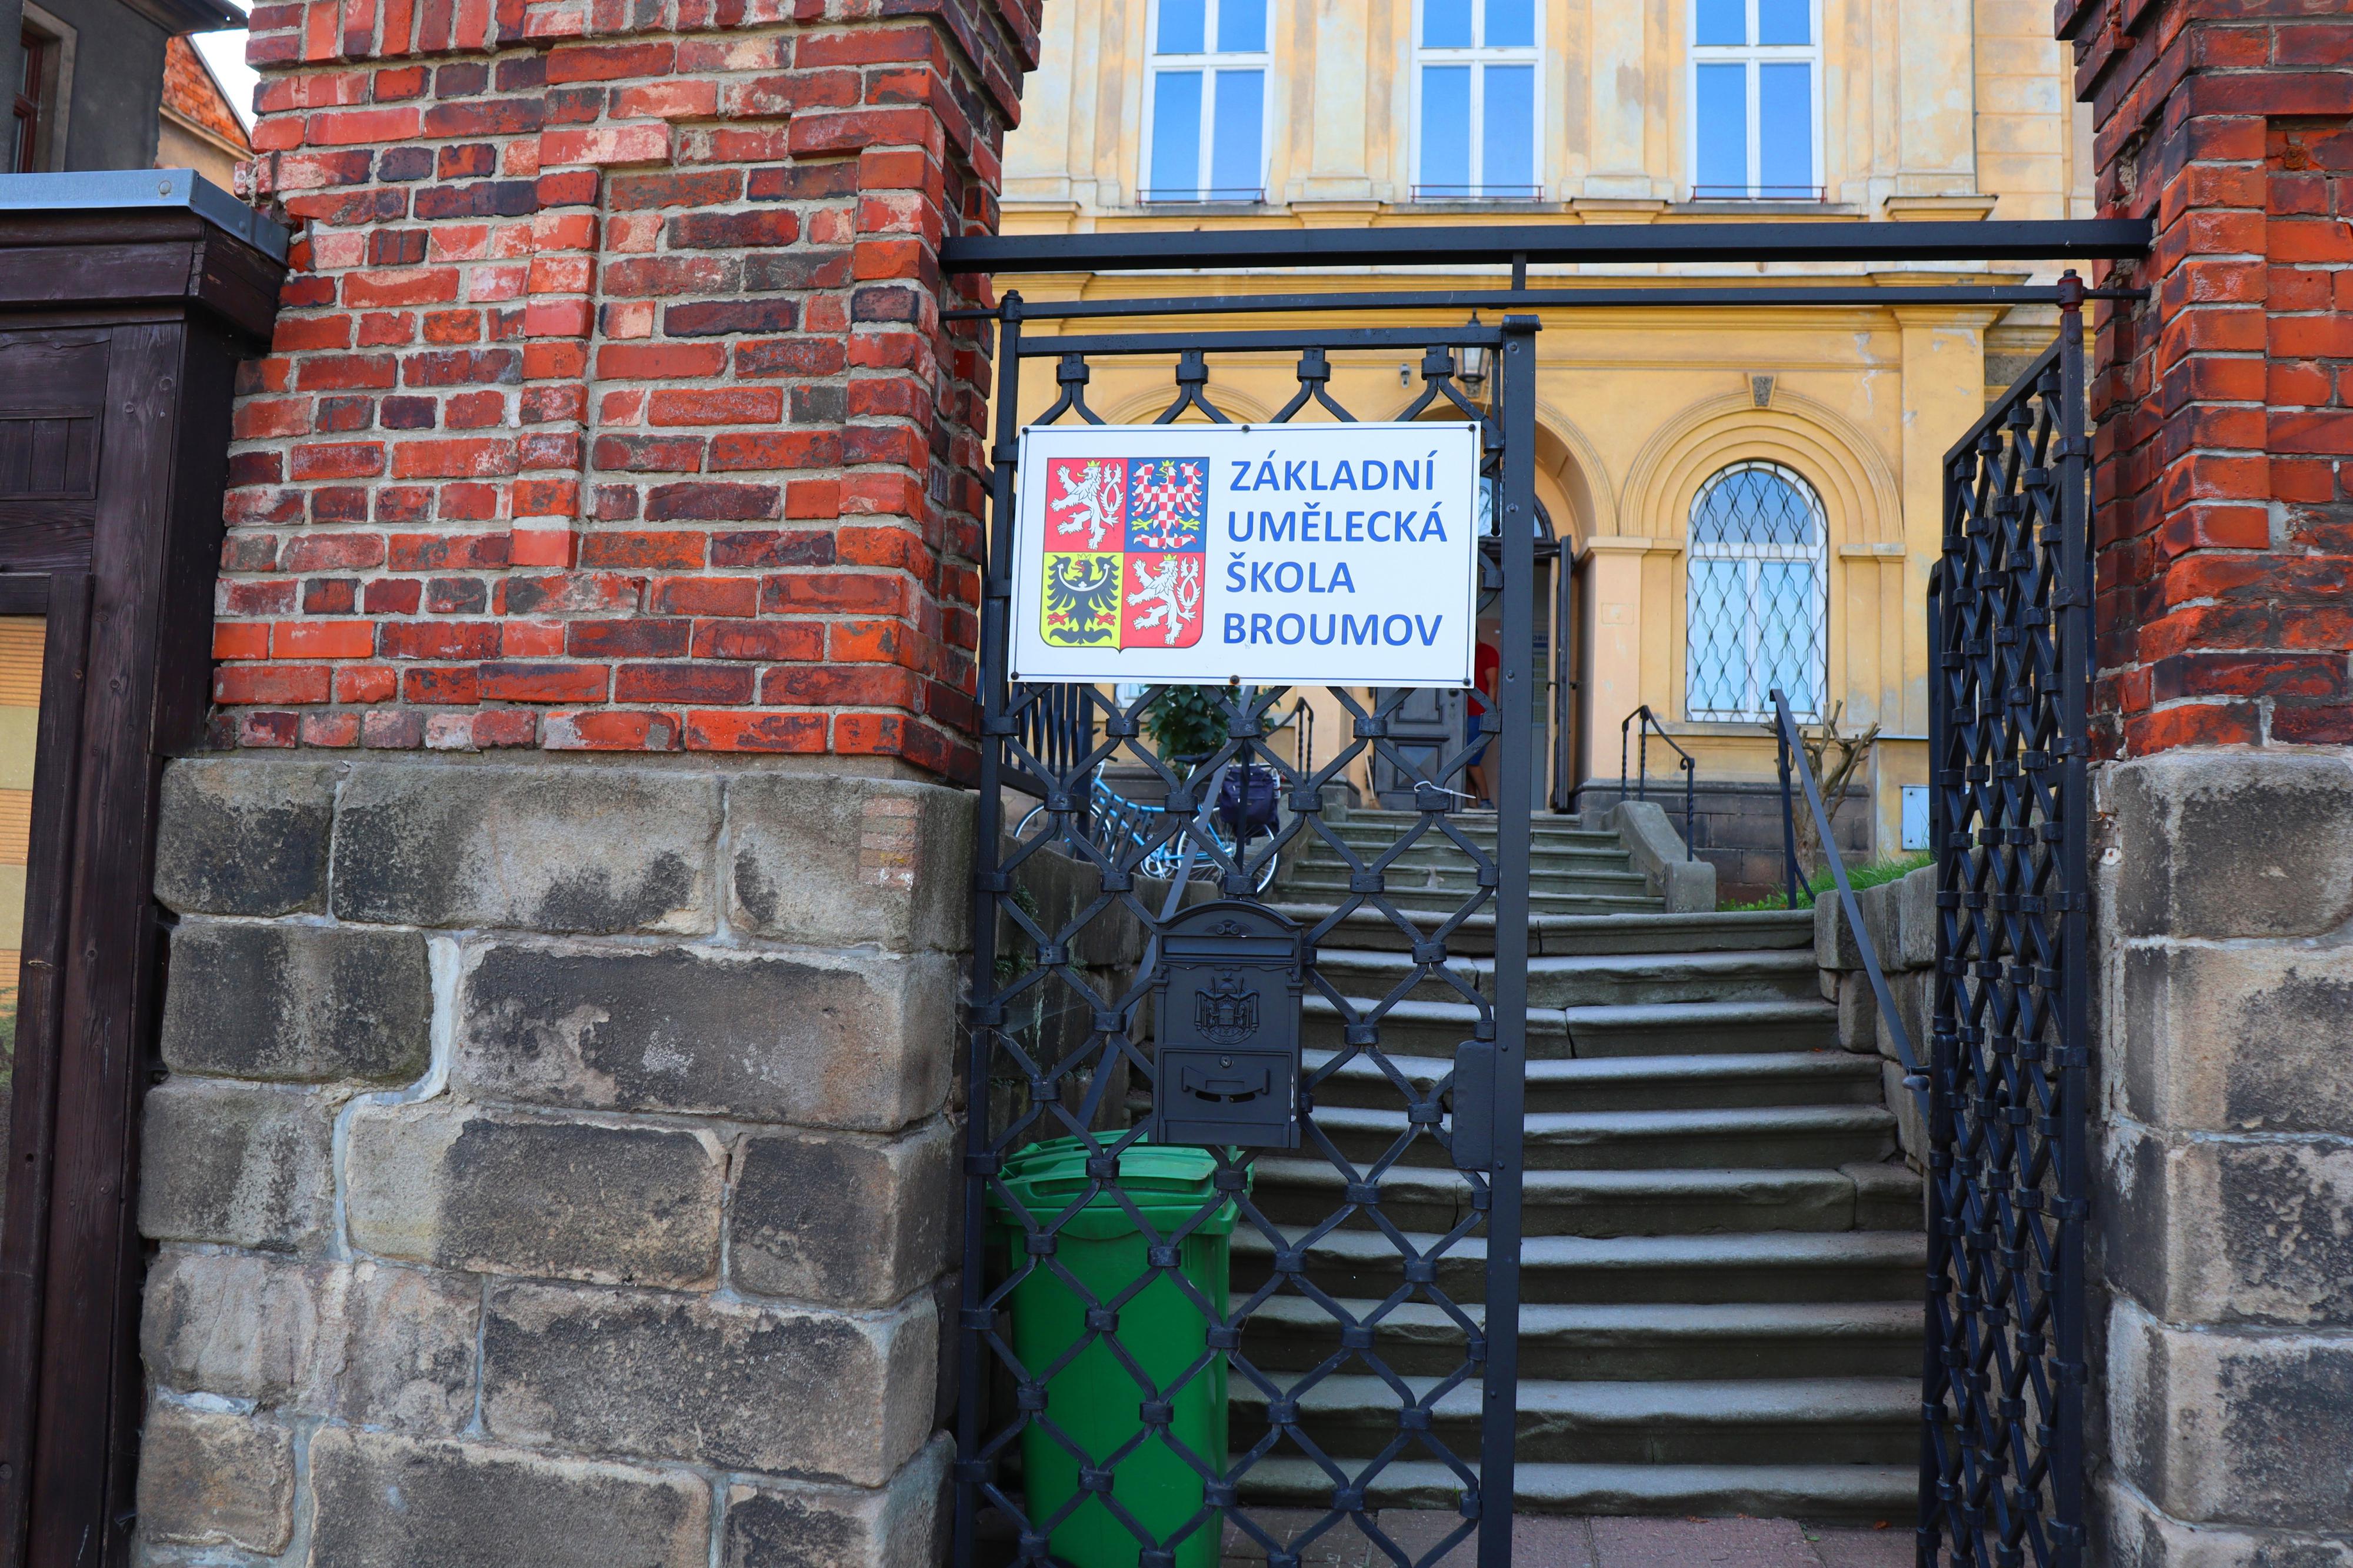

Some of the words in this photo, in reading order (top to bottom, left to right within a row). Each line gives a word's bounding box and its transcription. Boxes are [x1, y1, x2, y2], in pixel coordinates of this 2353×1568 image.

[1230, 450, 1438, 491] ZÁKLADNÍ
[1228, 502, 1448, 542] UMĚLECKÁ
[1226, 552, 1356, 593] ŠKOLA
[1224, 613, 1443, 646] BROUMOV
